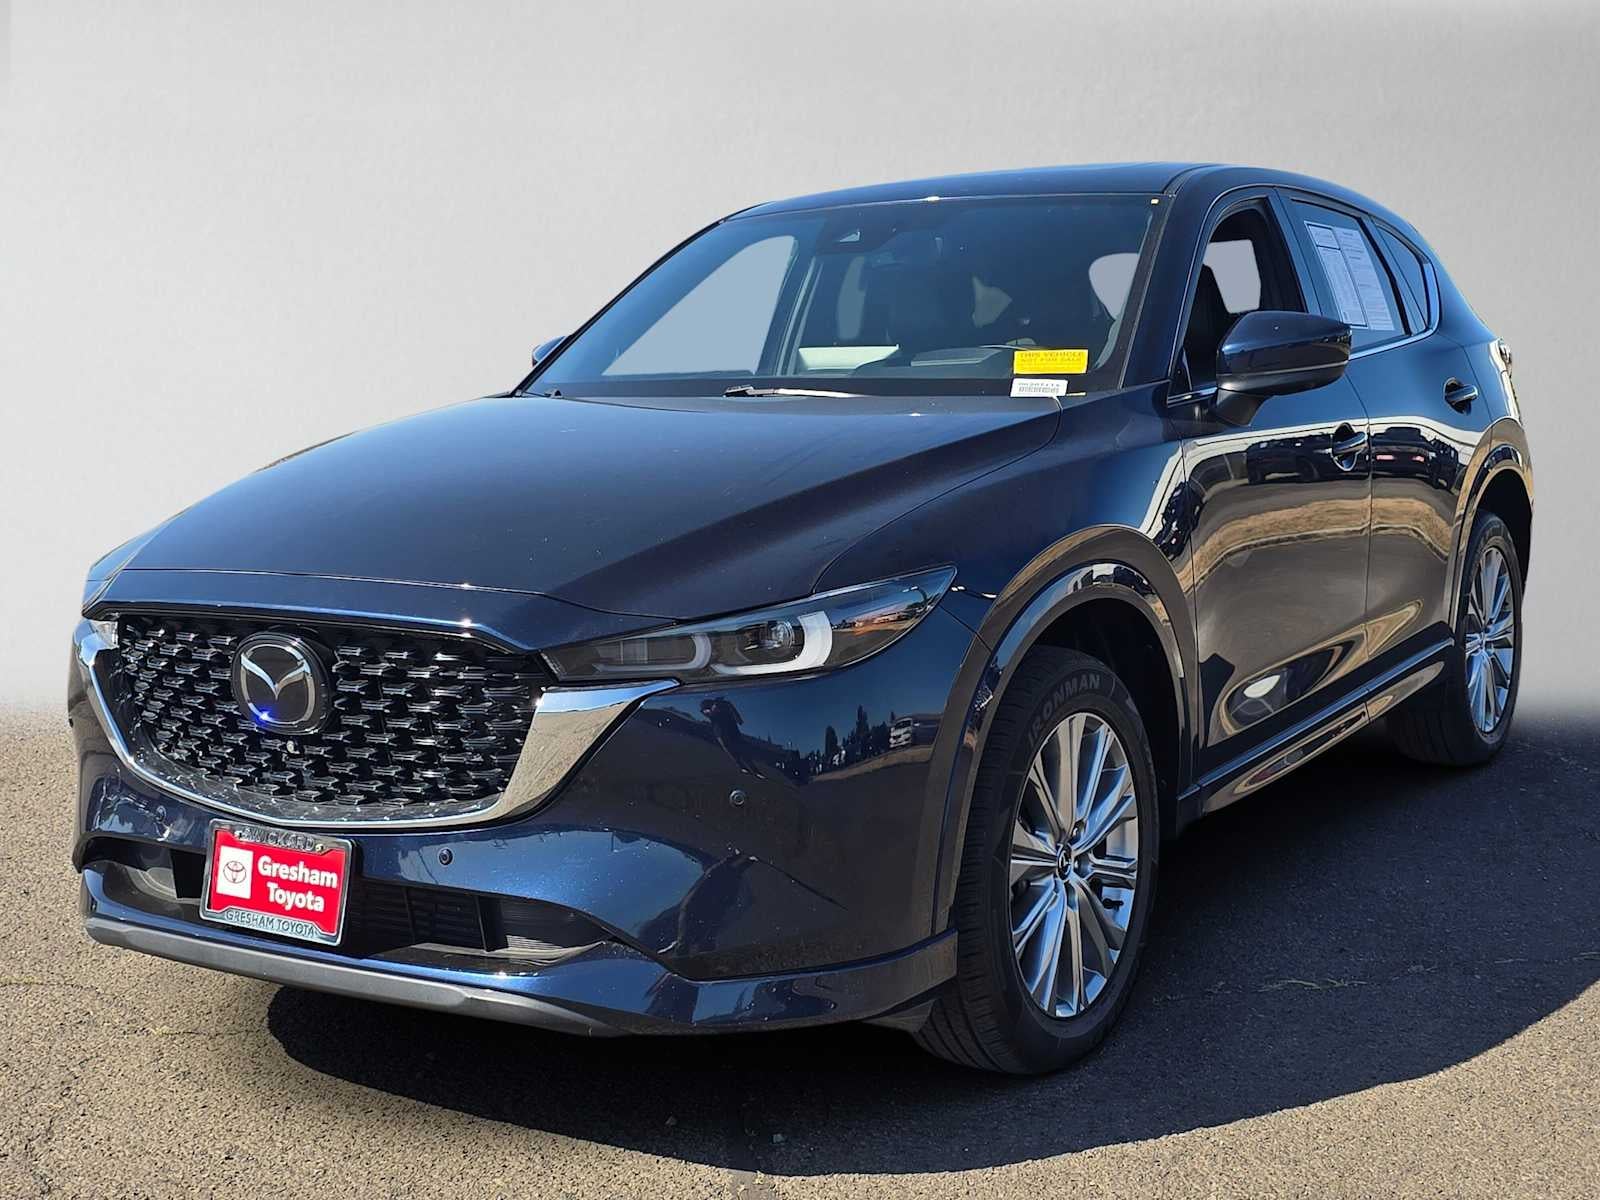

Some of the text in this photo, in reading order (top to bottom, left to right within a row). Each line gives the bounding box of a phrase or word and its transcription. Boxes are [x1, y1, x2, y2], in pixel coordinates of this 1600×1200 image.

[1027, 673, 1101, 749] IRONMAN
[257, 855, 338, 888] Gresham
[266, 881, 325, 912] Toyota
[225, 910, 316, 937] GRESHAM TOYOTA
